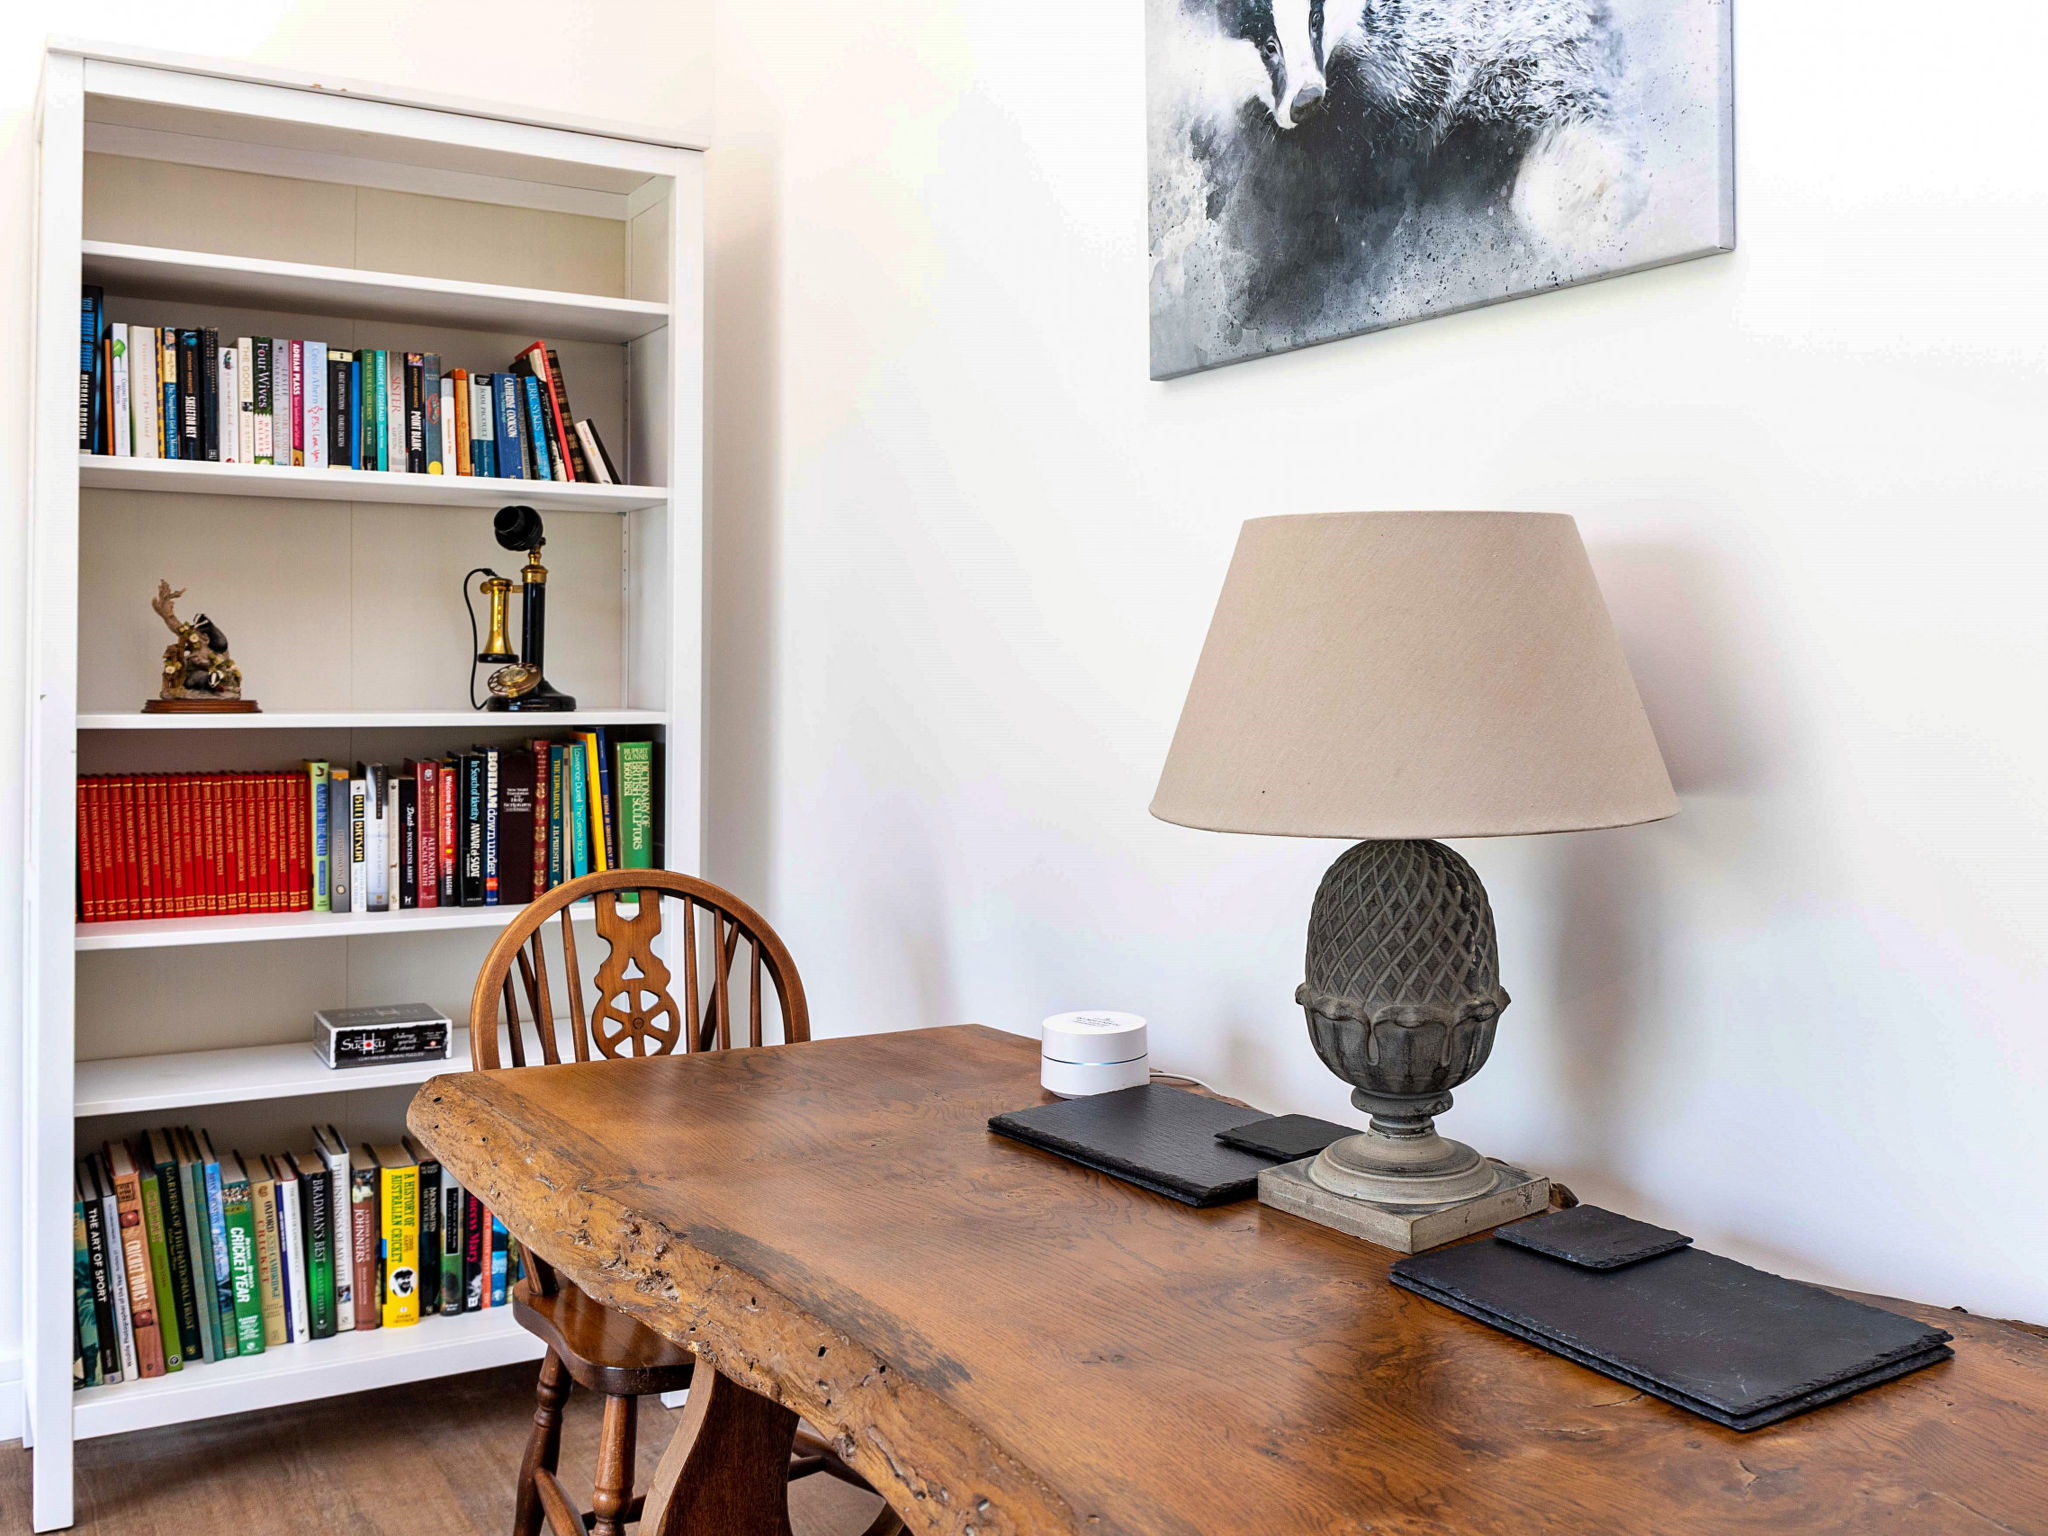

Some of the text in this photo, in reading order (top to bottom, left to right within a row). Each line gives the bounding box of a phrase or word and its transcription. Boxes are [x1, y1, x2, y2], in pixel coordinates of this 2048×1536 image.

[258, 343, 270, 408] Four Wives
[292, 373, 300, 396] PLASS
[391, 376, 402, 414] SISTER
[184, 396, 197, 438] SKELETON KEY
[504, 378, 518, 438] CATHERINE COOKSON
[528, 383, 536, 401] ERIC
[532, 404, 542, 430] SYKES
[410, 411, 422, 452] POINT BLANC
[471, 768, 480, 788] Search
[574, 748, 582, 782] Lawrence
[624, 762, 632, 796] 1660-1851
[354, 795, 364, 818] BILL
[406, 806, 415, 826] Death
[470, 796, 480, 820] Identity
[487, 752, 498, 875] BOTHAM down under
[553, 774, 561, 820] EDWARDIANS
[632, 762, 642, 850] BRITISH SCULPTORS
[640, 762, 650, 828] DICTIONARY OF
[354, 820, 364, 862] BRYSON
[444, 813, 453, 844] Everytown
[470, 822, 480, 849] ANWAR
[428, 836, 437, 886] ALEXANDER
[470, 856, 480, 878] SADAT
[166, 1166, 177, 1212] GARDENS
[404, 1182, 416, 1218] HISTORY
[430, 1187, 438, 1232] MOUNTBATTEN
[146, 1190, 162, 1242] CRICKET
[173, 1214, 180, 1227] OF
[265, 1201, 275, 1232] OXFORD
[312, 1180, 326, 1264] BRADMAN'S BEST
[332, 1164, 346, 1283] THE INNINGS OF MY LIFE
[355, 1210, 366, 1263] JOHNNERS
[391, 1175, 402, 1263] AUSTRALIAN CRICKET
[404, 1218, 415, 1227] OF
[89, 1208, 107, 1302] THE ART OF SPORT
[174, 1230, 182, 1248] THE
[230, 1228, 246, 1271] CRICKET
[257, 1220, 269, 1284] CRICKET
[468, 1233, 480, 1263] Mary
[126, 1240, 150, 1302] CRICKET TOURS
[176, 1250, 188, 1298] NATIONAL
[237, 1275, 250, 1302] YEAR
[269, 1254, 280, 1298] CAMBRIDGE
[184, 1302, 194, 1330] TRUST
